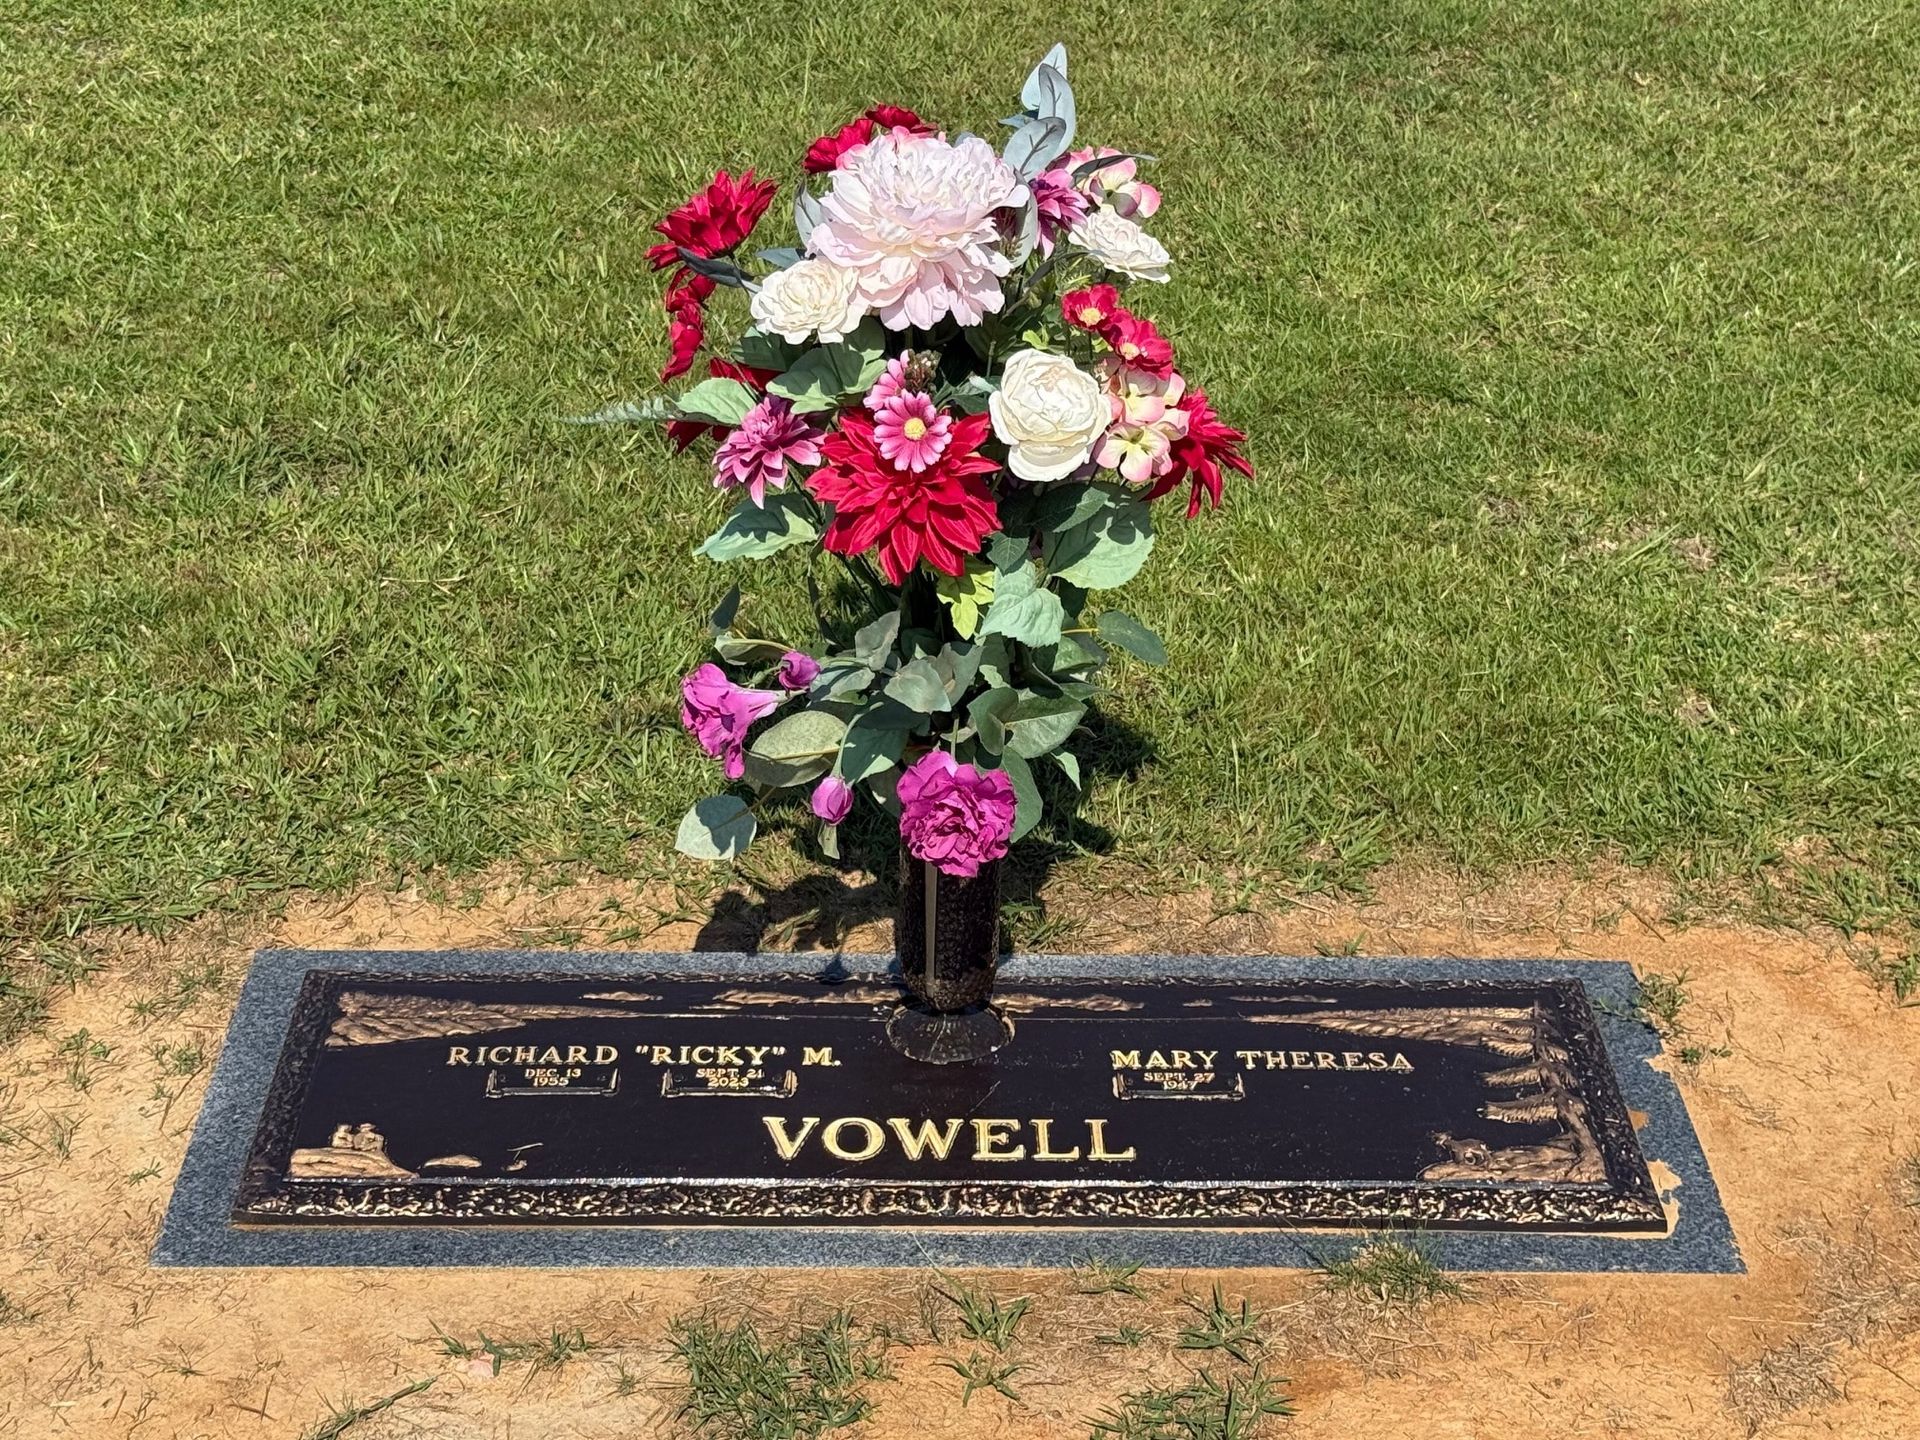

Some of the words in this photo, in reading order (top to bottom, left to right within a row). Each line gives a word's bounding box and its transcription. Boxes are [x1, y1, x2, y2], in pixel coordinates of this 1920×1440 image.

[447, 1045, 619, 1066] RICHARD
[802, 1046, 842, 1067] M.
[1109, 1049, 1219, 1070] MARY
[1235, 1050, 1415, 1072] THERESA
[566, 1068, 582, 1079] 13
[695, 1068, 740, 1079] SEPT.
[746, 1068, 764, 1079] 21
[1143, 1072, 1188, 1082] SEPT.
[1193, 1072, 1216, 1083] 27
[533, 1077, 569, 1088] 1955
[707, 1077, 750, 1088] 2023
[1162, 1080, 1198, 1091] 1947
[762, 1116, 1137, 1162] VOWELL
